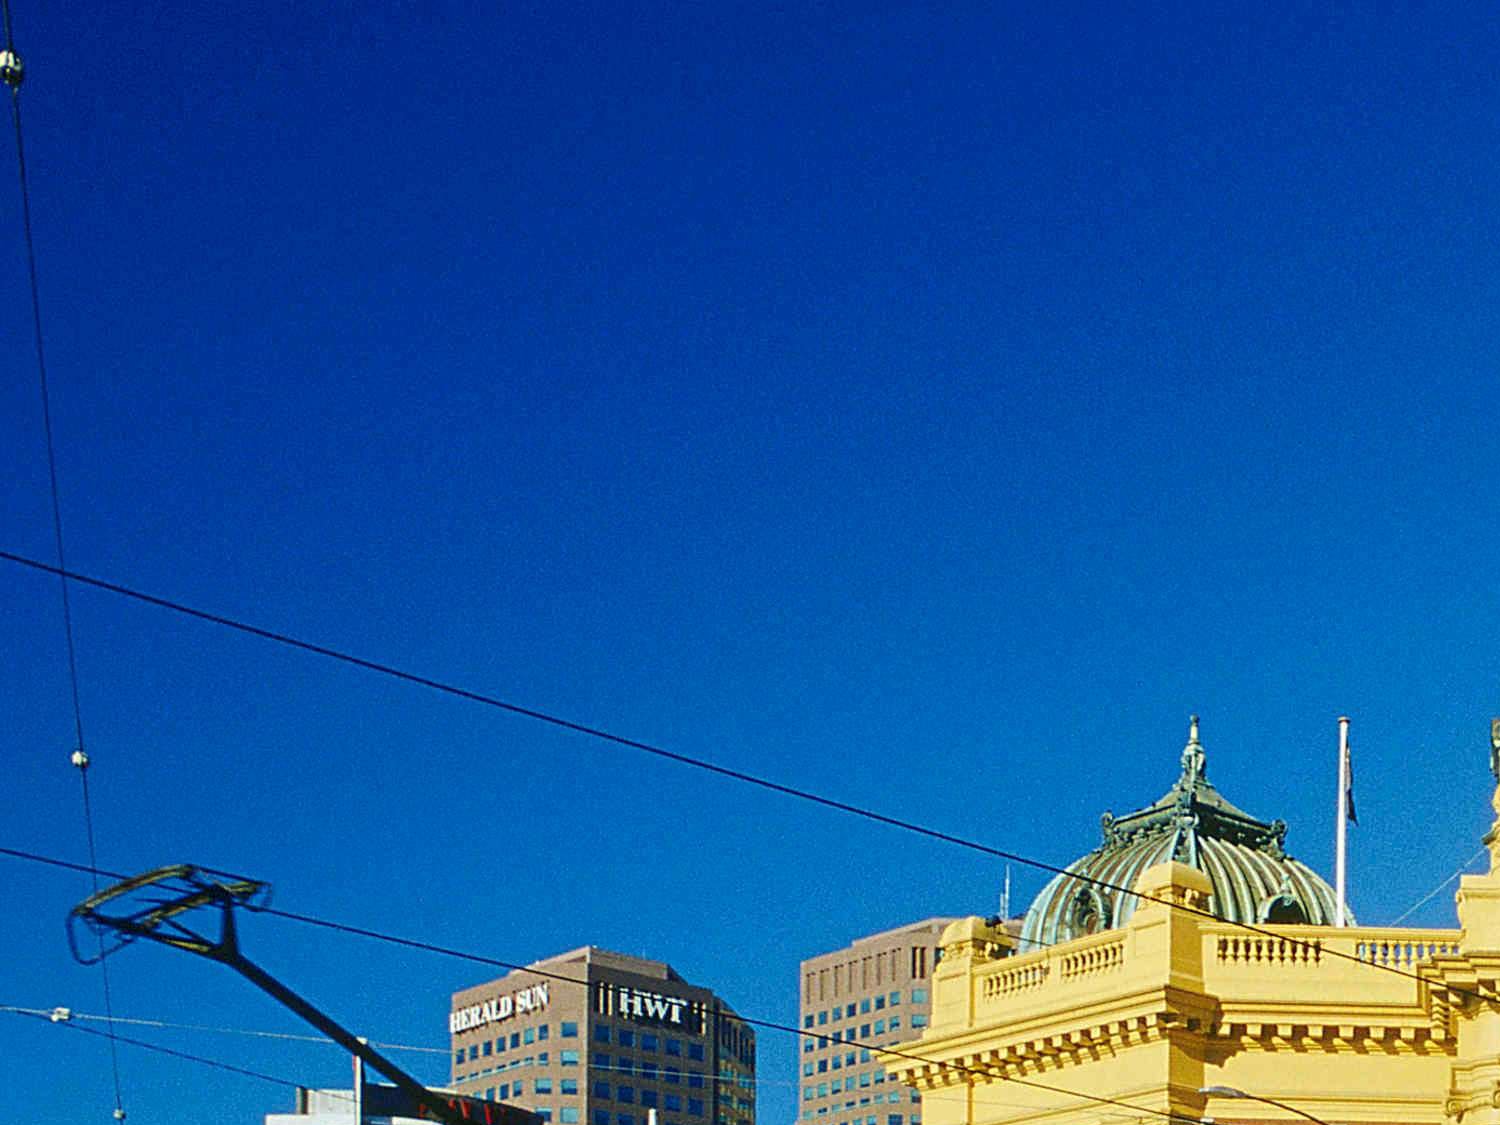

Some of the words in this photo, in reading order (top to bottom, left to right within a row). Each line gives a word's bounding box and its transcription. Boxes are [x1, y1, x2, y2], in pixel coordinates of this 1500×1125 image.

[450, 997, 513, 1033] HERALD
[516, 983, 549, 1013] SUN
[618, 988, 688, 1024] HWT
